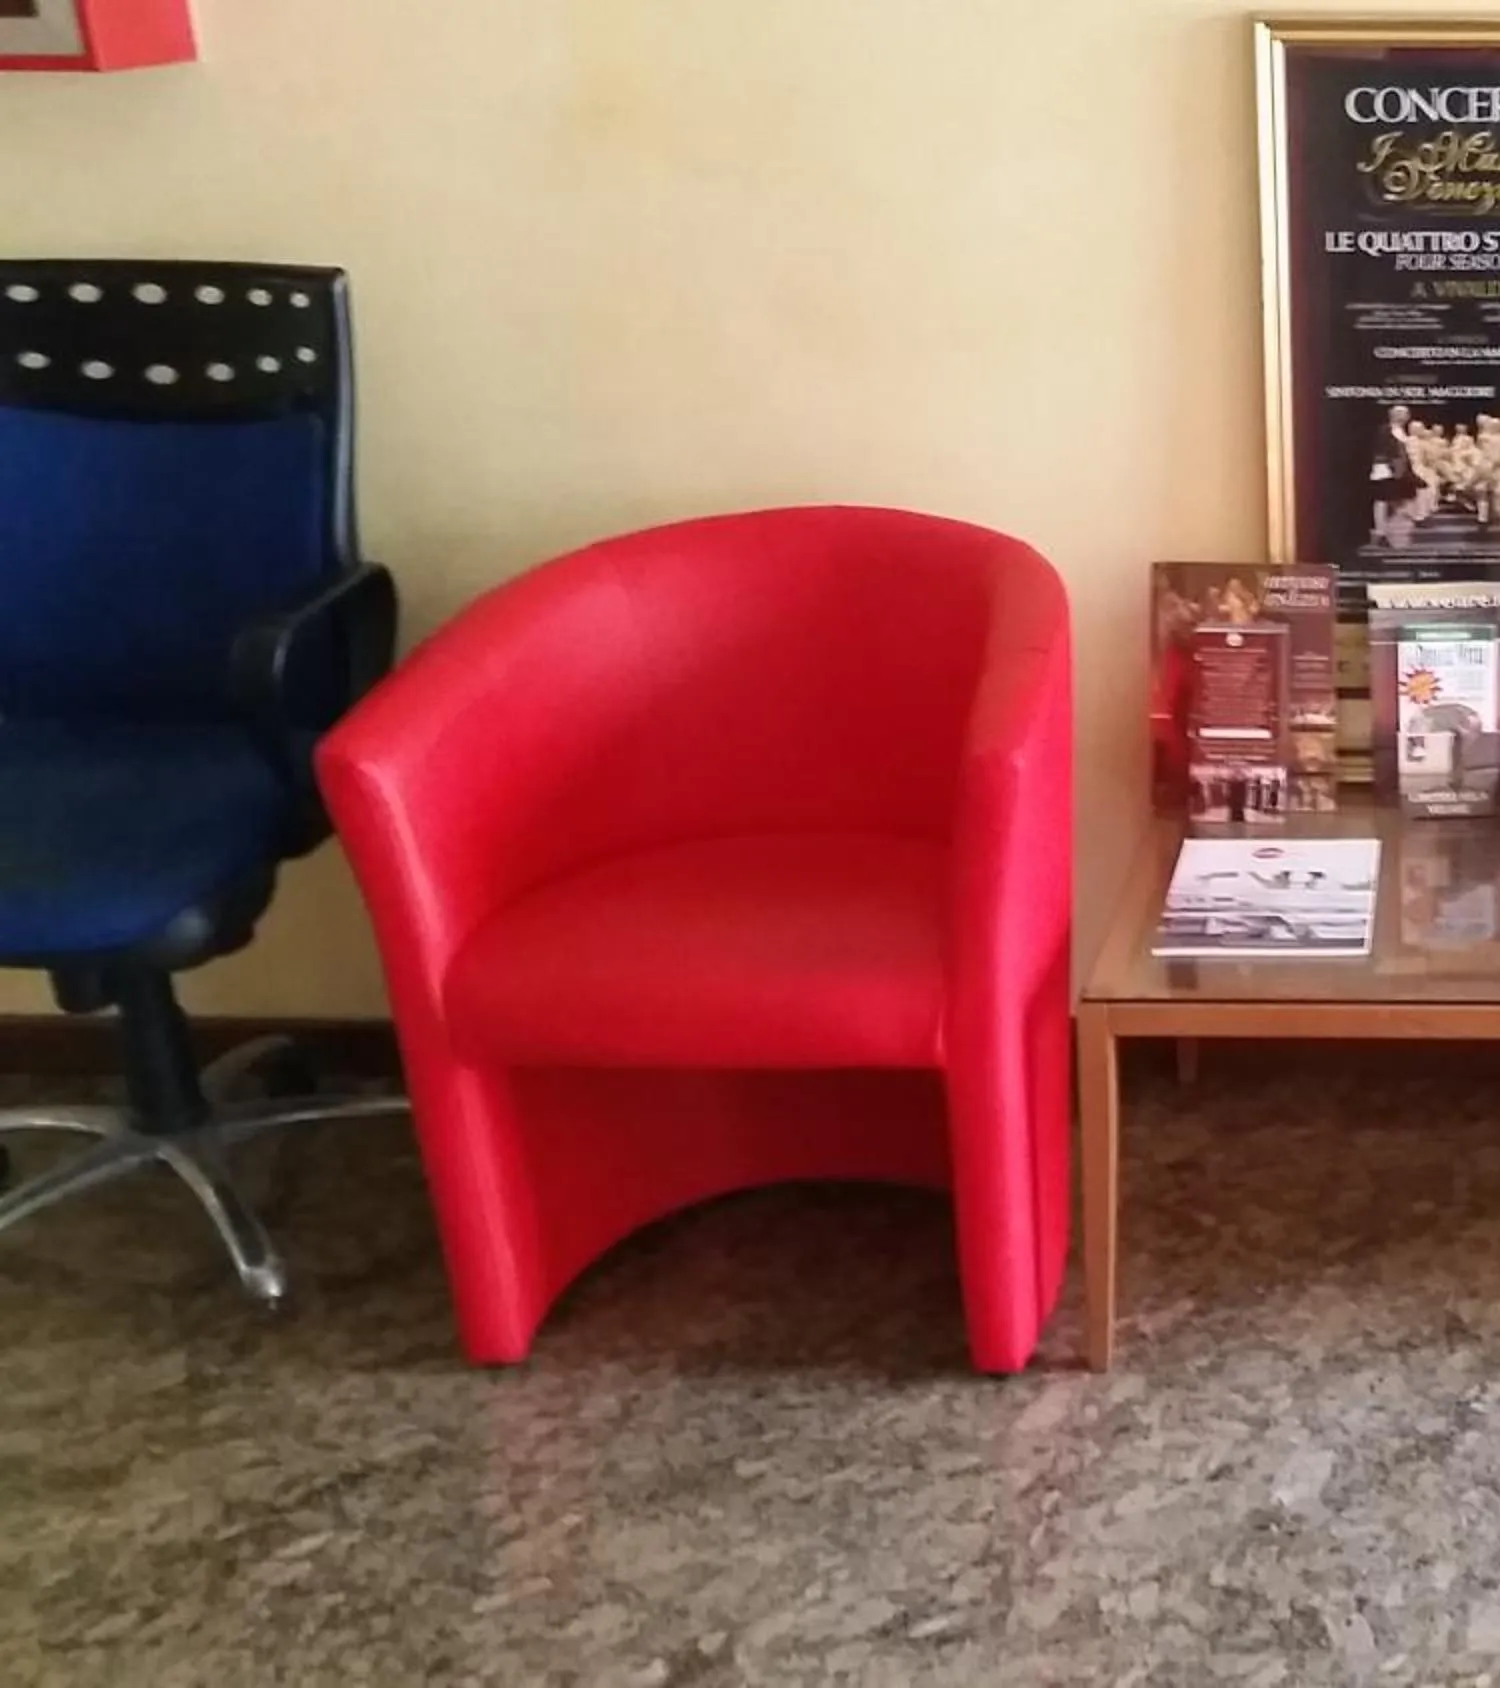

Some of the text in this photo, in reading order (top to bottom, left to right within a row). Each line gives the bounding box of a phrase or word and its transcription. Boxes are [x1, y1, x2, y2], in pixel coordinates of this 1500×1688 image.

[1325, 231, 1355, 252] LE
[1357, 231, 1480, 256] QUATTRO
[1394, 254, 1446, 271] FOUR
